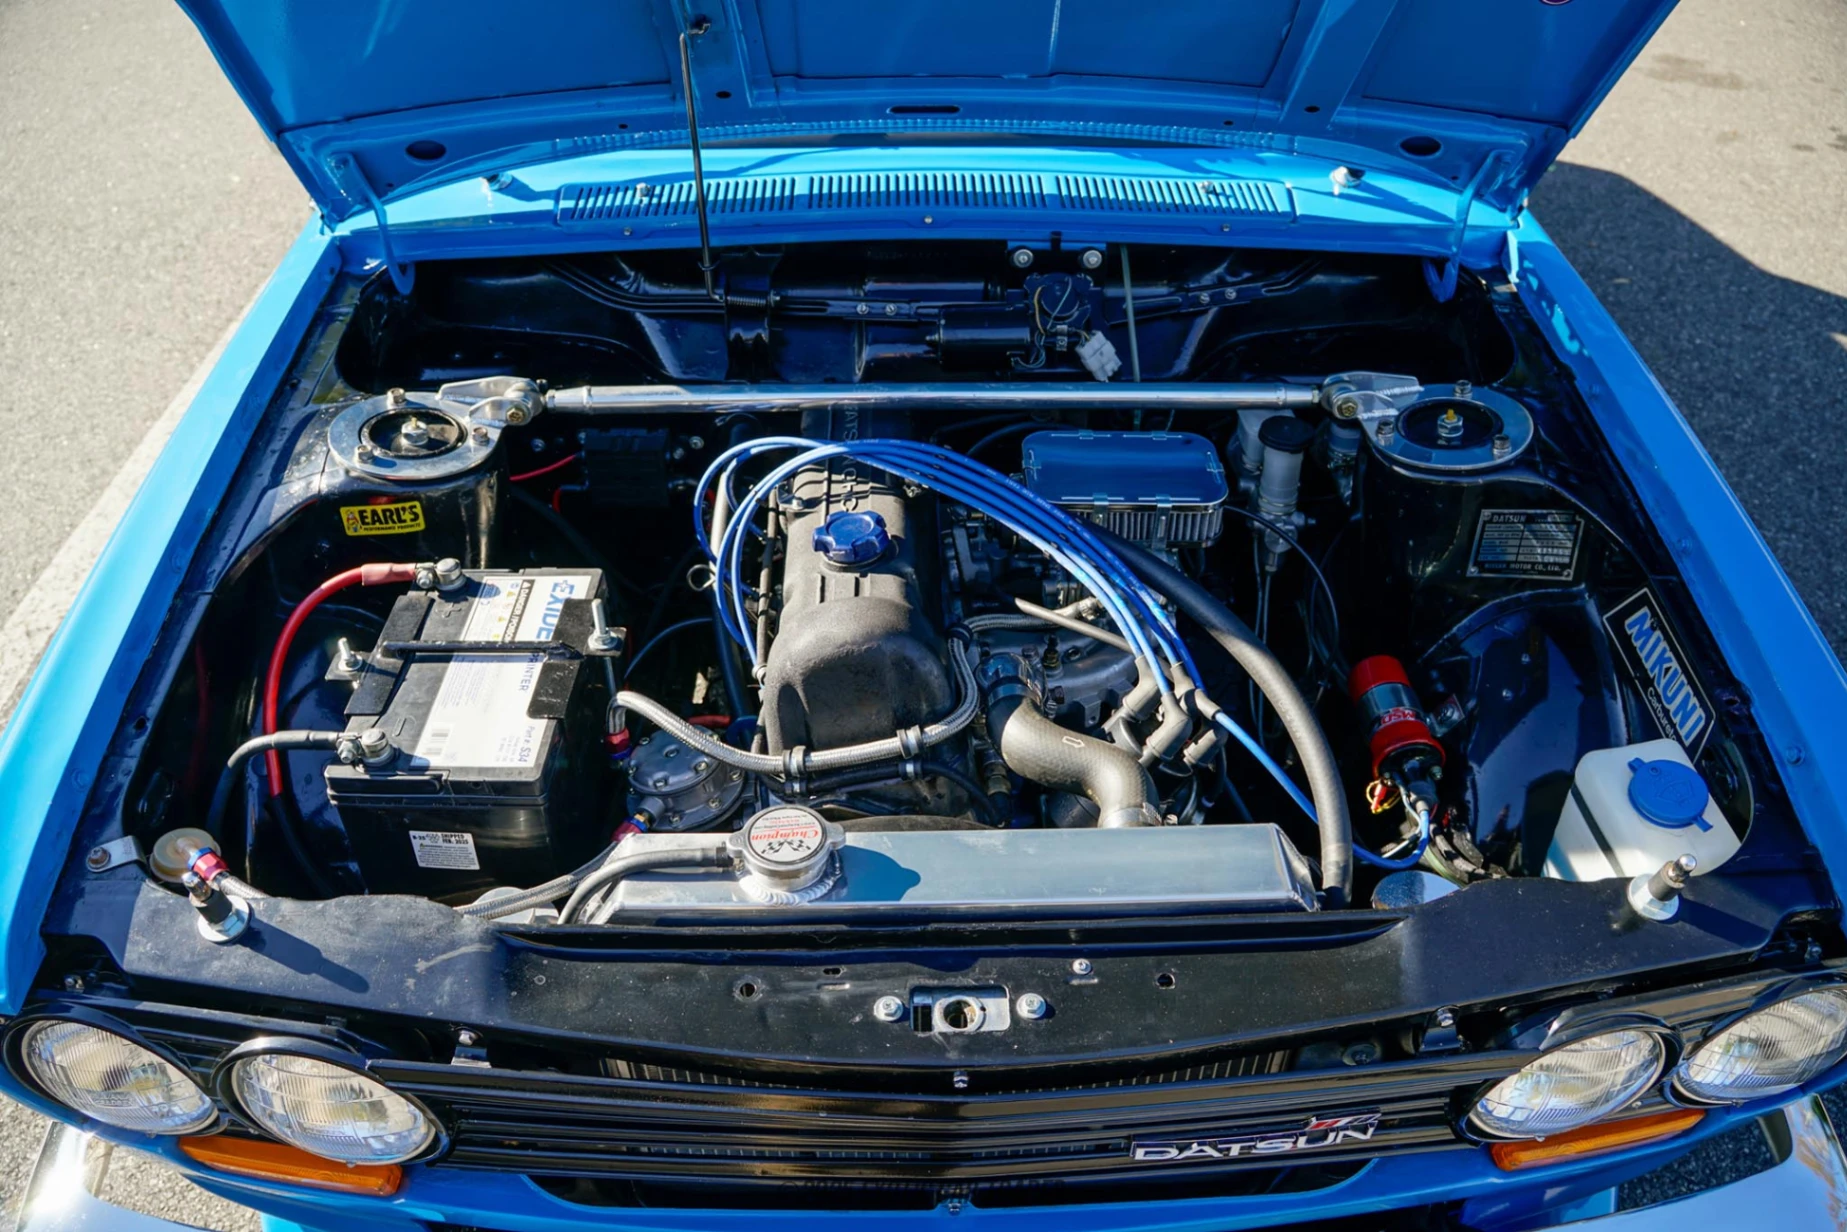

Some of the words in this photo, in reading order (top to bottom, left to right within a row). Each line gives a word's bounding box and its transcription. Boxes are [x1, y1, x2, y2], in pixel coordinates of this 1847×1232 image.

[358, 505, 420, 526] EARL'S
[1492, 514, 1527, 522] DATSUN
[513, 588, 530, 616] DANGER
[536, 580, 575, 640] EXIDE
[518, 652, 539, 692] PRINTER
[1624, 605, 1706, 748] MIKUNI
[1647, 687, 1677, 741] Carbureto
[751, 829, 819, 840] Champion
[1134, 1120, 1378, 1161] DATSUN
